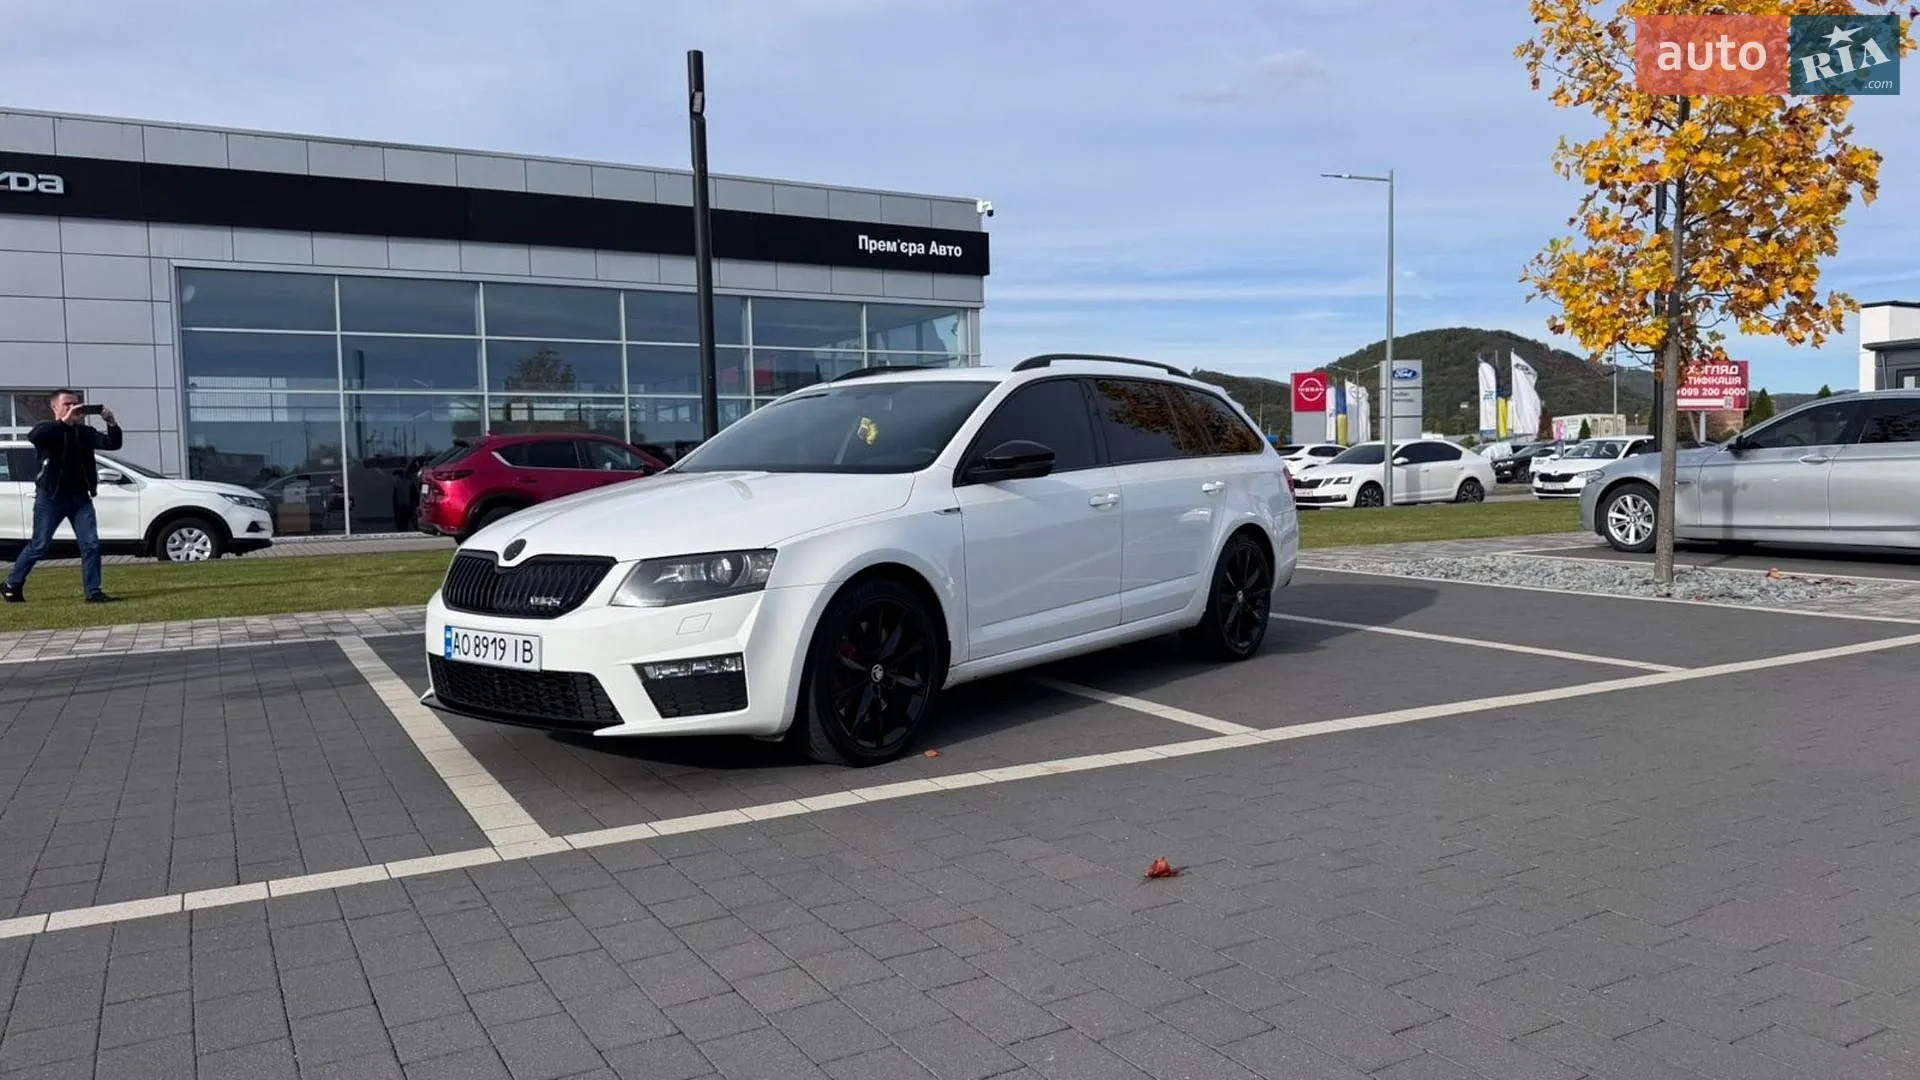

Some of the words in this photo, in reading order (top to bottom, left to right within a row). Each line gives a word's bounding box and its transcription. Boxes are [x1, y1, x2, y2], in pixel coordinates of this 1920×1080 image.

[858, 234, 925, 257] Прем'єра
[929, 240, 963, 258] Авто
[453, 632, 471, 656] AO
[473, 635, 507, 661] 8919
[514, 639, 534, 664] IB
